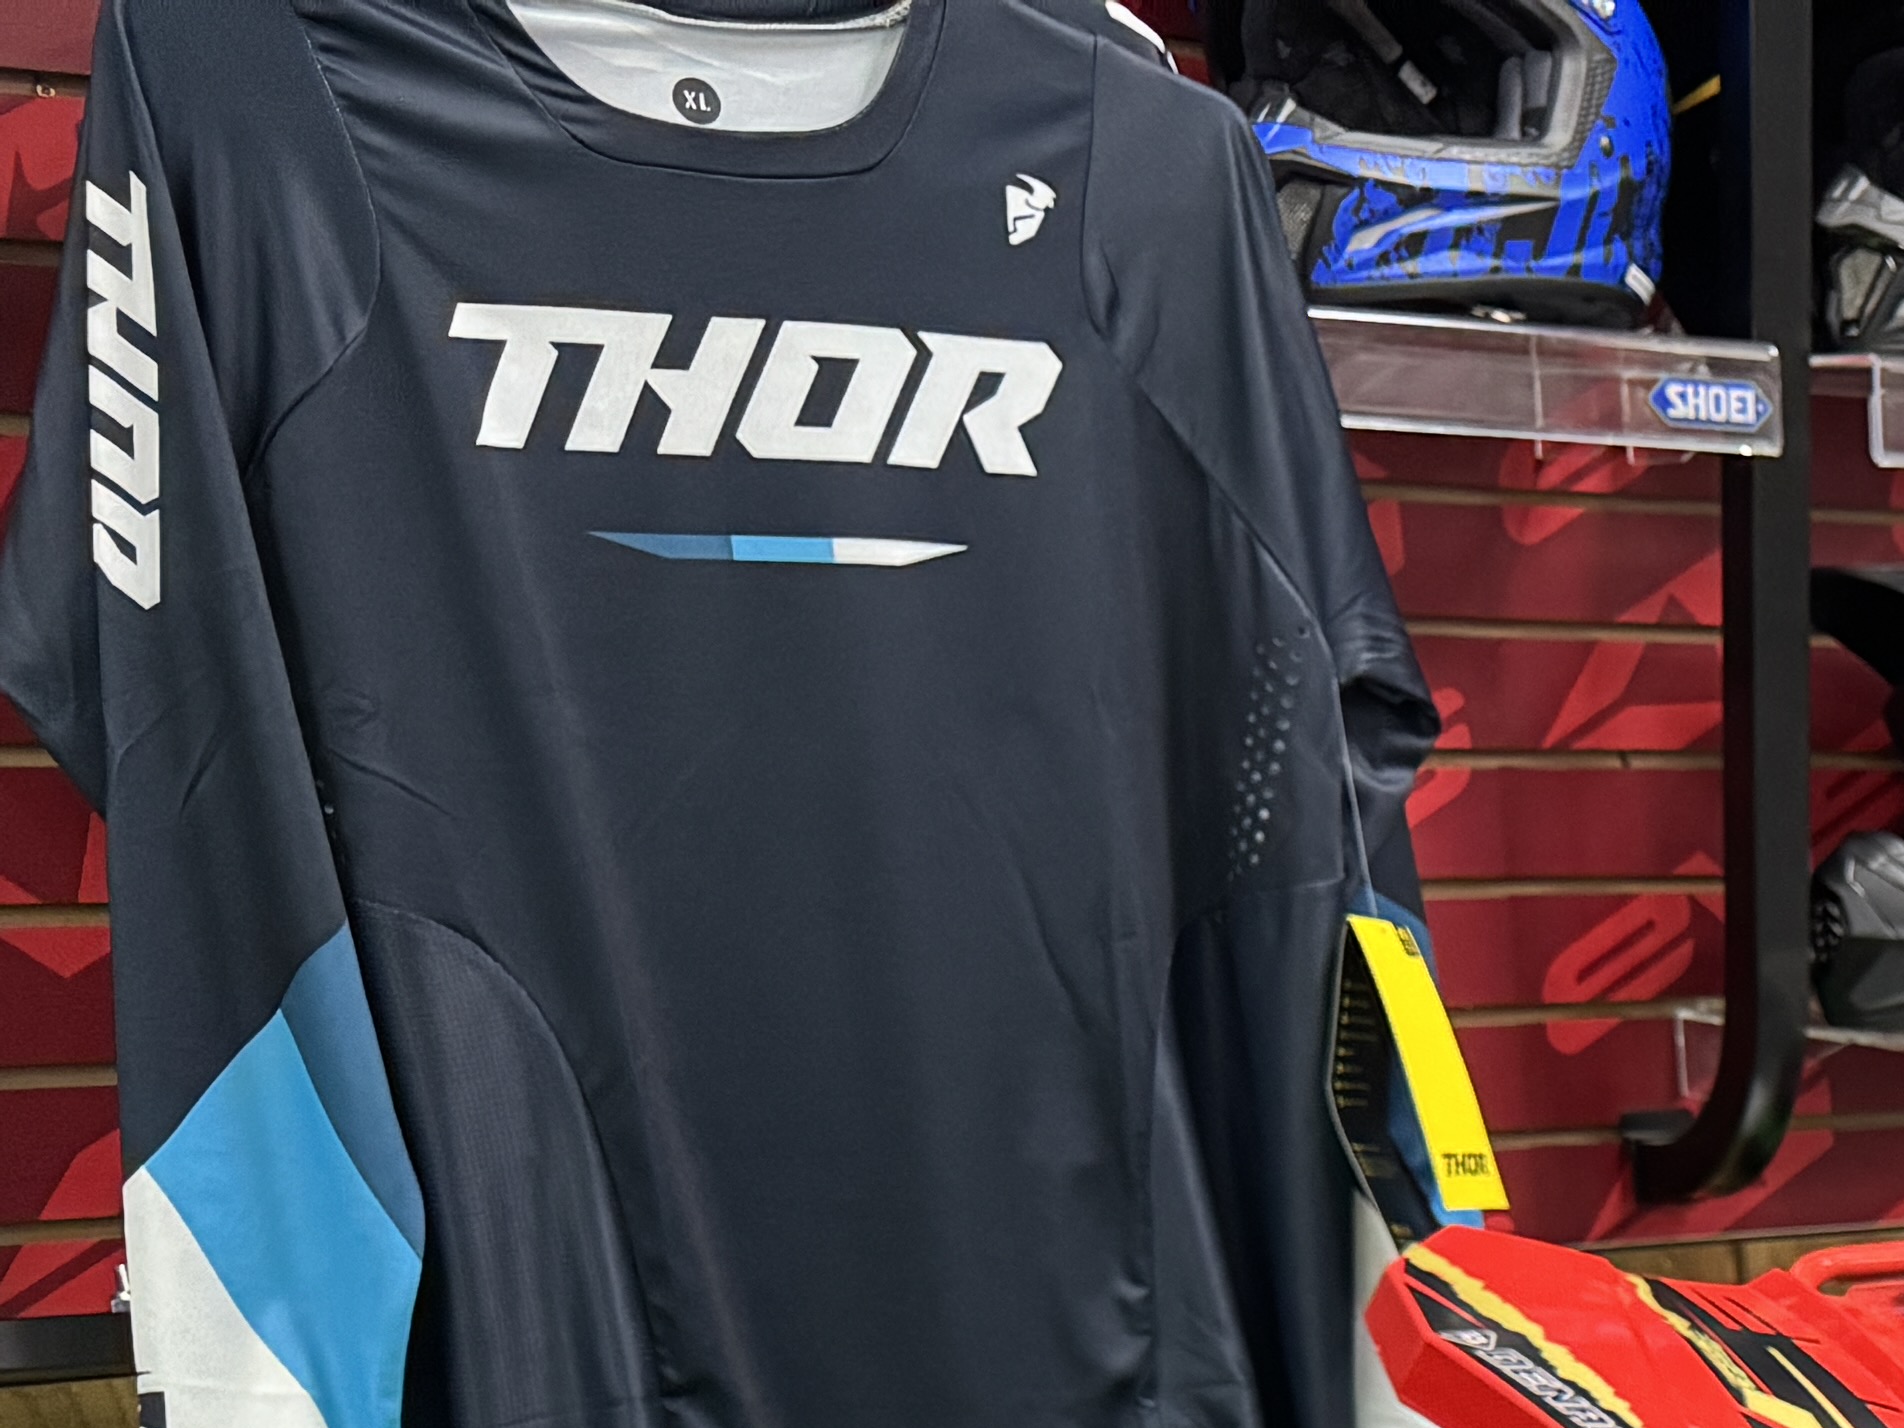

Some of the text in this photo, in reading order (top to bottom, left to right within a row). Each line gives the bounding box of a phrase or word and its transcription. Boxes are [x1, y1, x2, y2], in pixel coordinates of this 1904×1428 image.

[449, 301, 1064, 477] THOR
[1664, 383, 1758, 425] SHOEI
[1441, 1152, 1490, 1178] THOR
